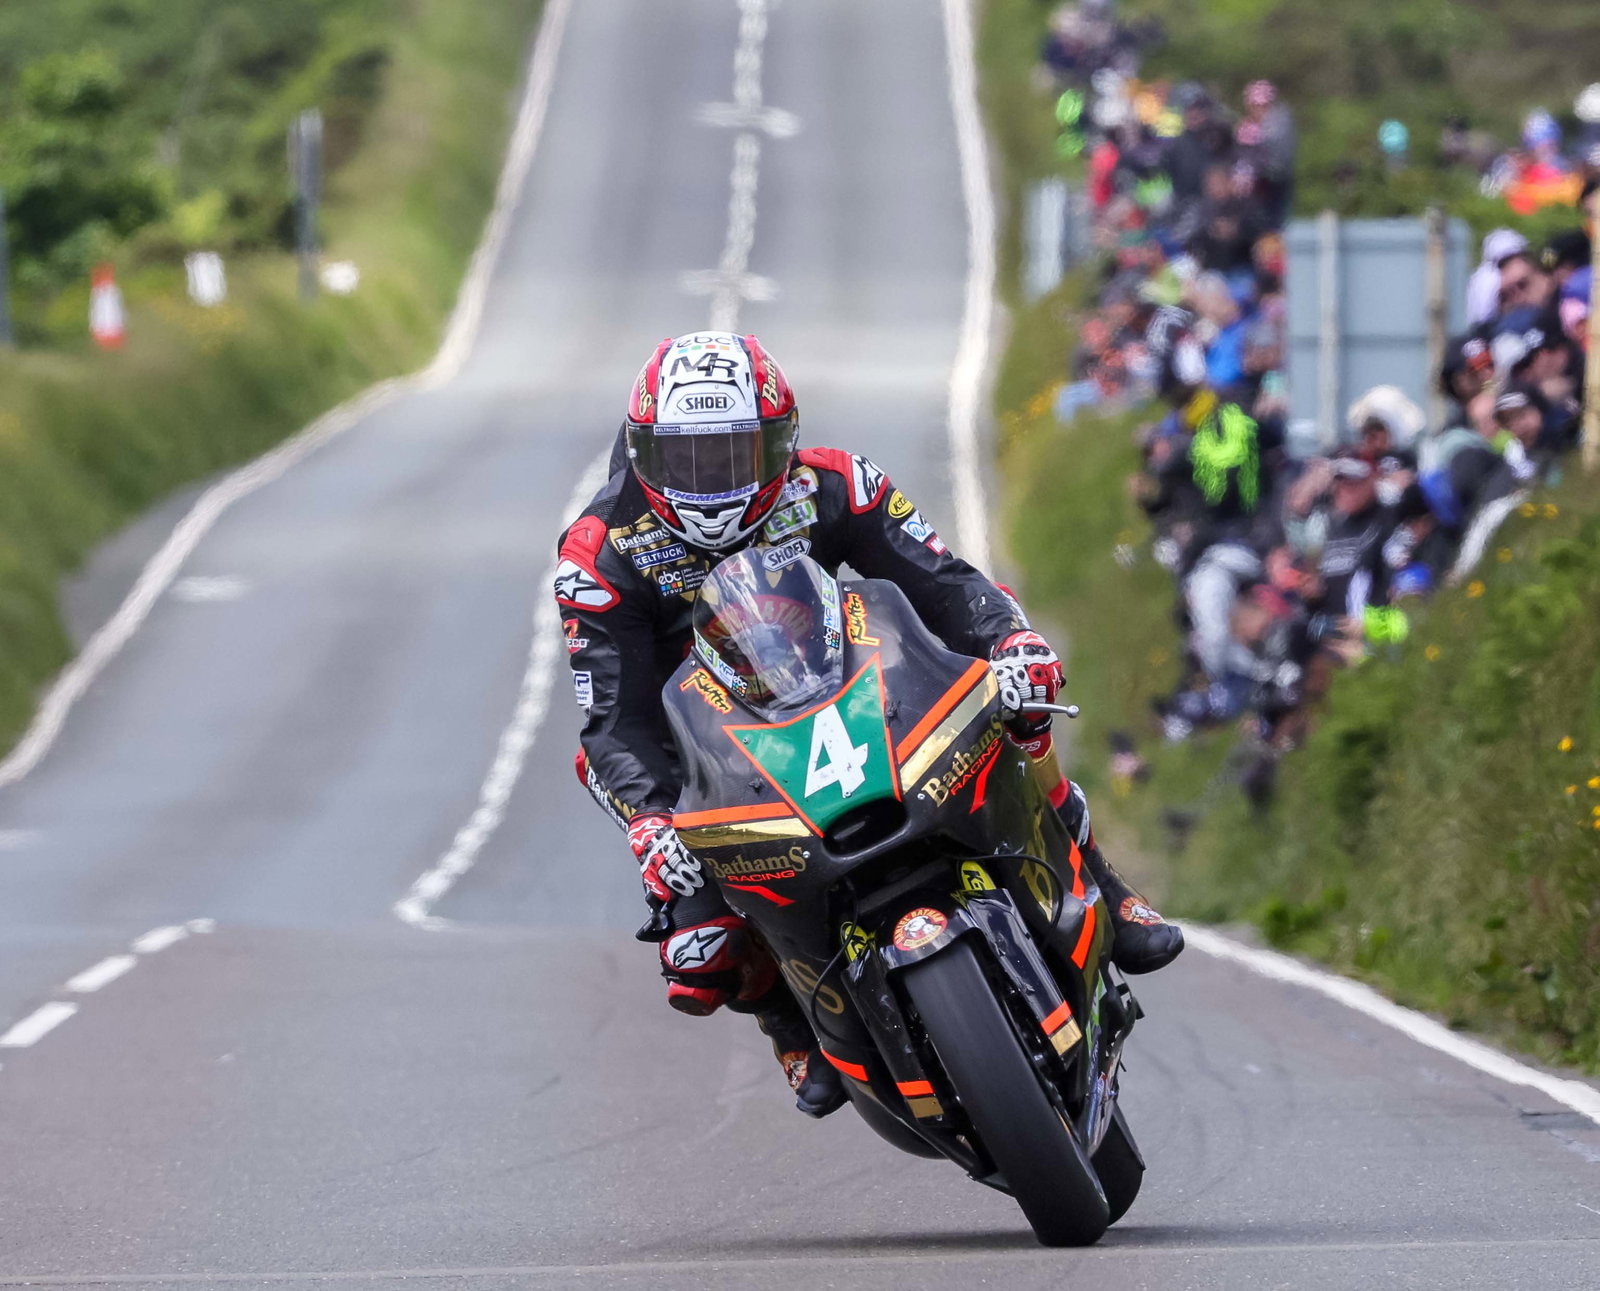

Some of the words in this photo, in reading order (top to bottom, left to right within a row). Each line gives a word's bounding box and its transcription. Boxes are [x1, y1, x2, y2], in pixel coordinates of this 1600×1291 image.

[685, 396, 728, 411] SHOEI
[667, 484, 755, 502] THOMPSON
[635, 546, 684, 566] KELTRUCK
[767, 540, 806, 567] SHOEI
[658, 570, 682, 585] ebc
[823, 627, 833, 645] ebc
[804, 703, 868, 798] 4
[950, 737, 1000, 796] RACING
[728, 870, 796, 882] RACING
